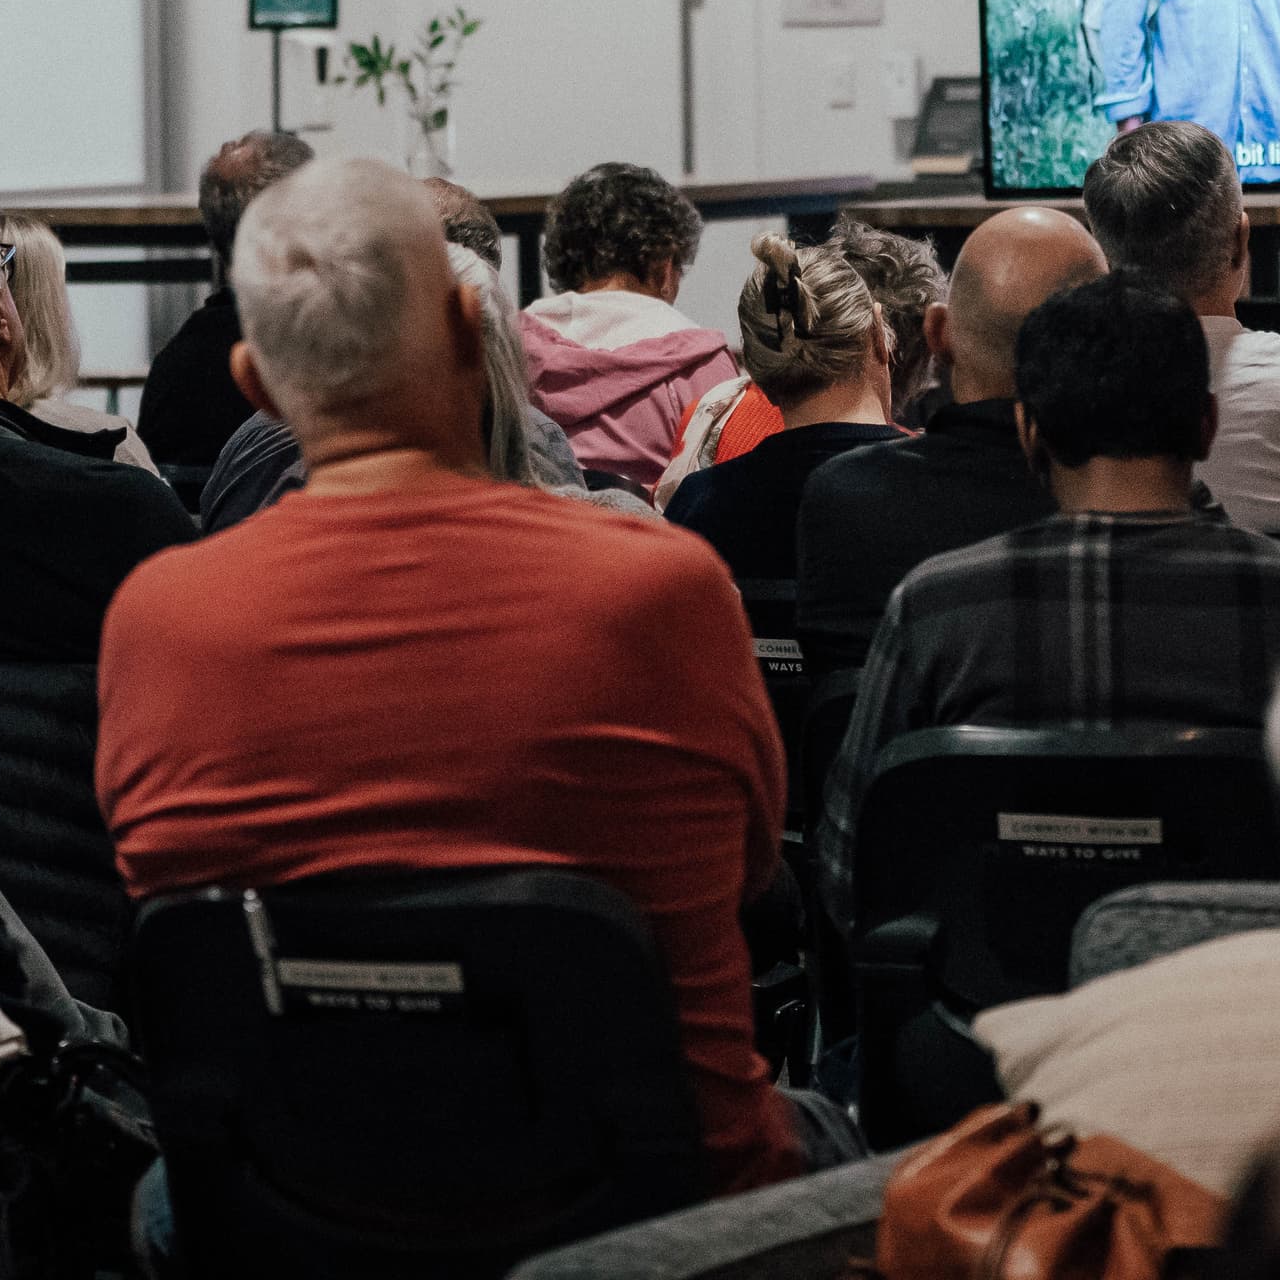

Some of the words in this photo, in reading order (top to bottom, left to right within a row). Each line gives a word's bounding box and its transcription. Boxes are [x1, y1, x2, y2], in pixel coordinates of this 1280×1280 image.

[1236, 143, 1264, 167] bit
[768, 662, 803, 672] WAYS
[1022, 845, 1068, 859] WAYS
[1072, 847, 1097, 860] TO
[1102, 848, 1141, 862] GIVE
